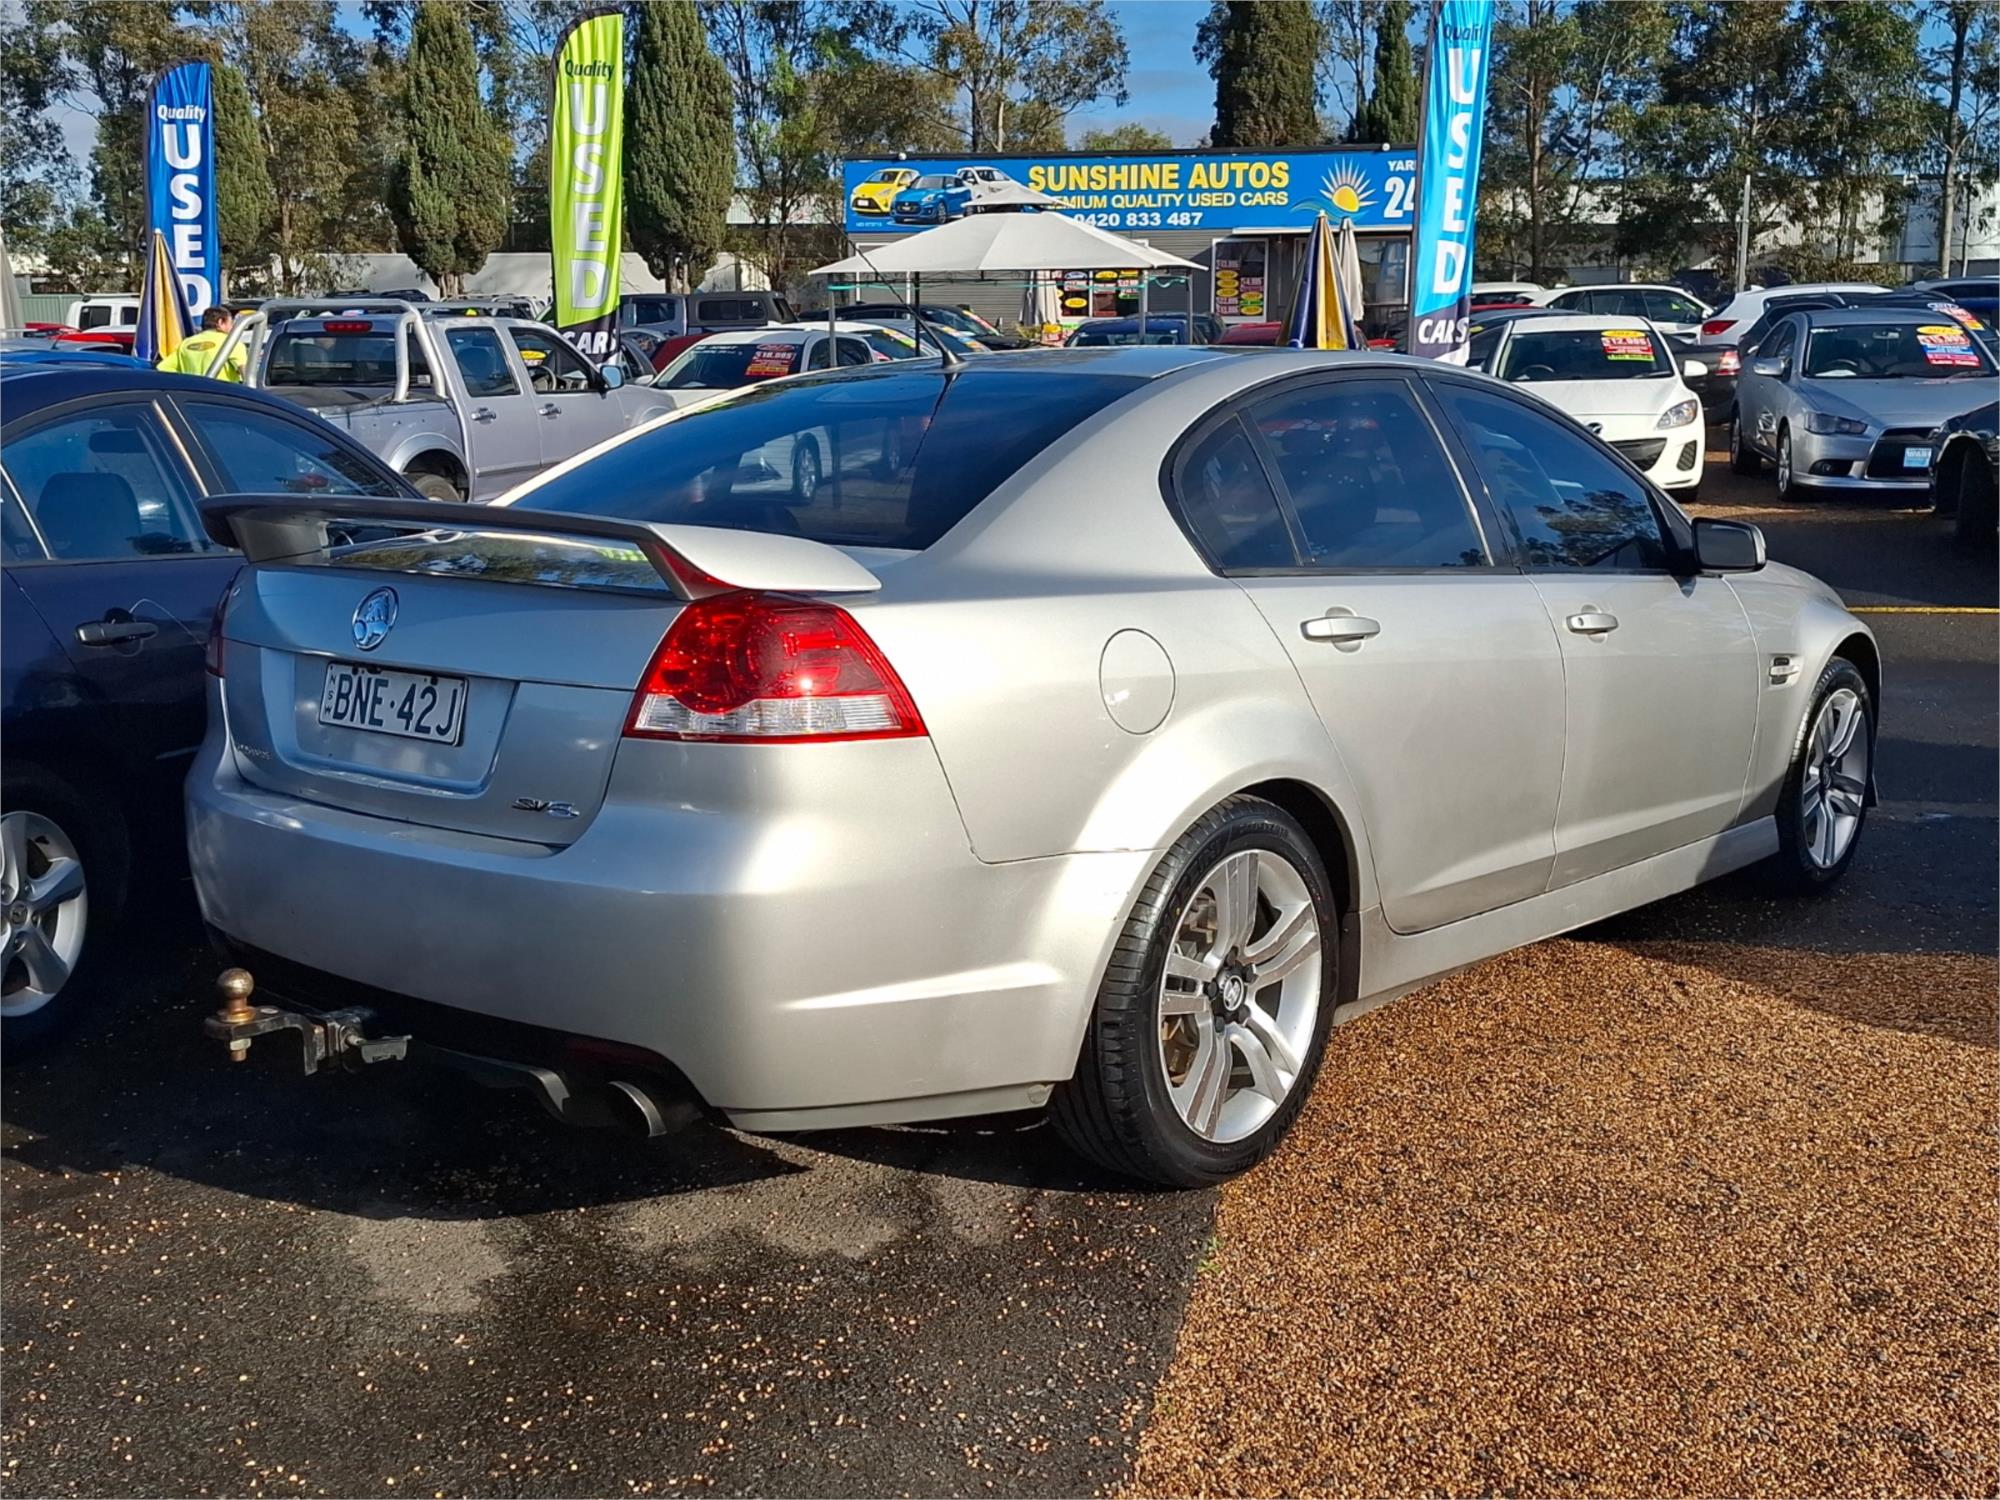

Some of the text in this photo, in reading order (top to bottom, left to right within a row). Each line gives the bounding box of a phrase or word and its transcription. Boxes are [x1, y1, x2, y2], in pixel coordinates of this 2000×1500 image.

[565, 59, 615, 81] Quality
[157, 105, 207, 123] Quality
[1028, 161, 1290, 192] SUNSHINE AUTOS
[1432, 48, 1481, 295] USED
[569, 83, 611, 309] USED
[1111, 193, 1185, 209] QUALITY
[1187, 192, 1235, 207] USED
[1239, 191, 1289, 206] CARS
[163, 124, 212, 317] USED
[1126, 212, 1162, 227] 833
[1166, 212, 1203, 226] 487
[1418, 318, 1469, 345] CARS
